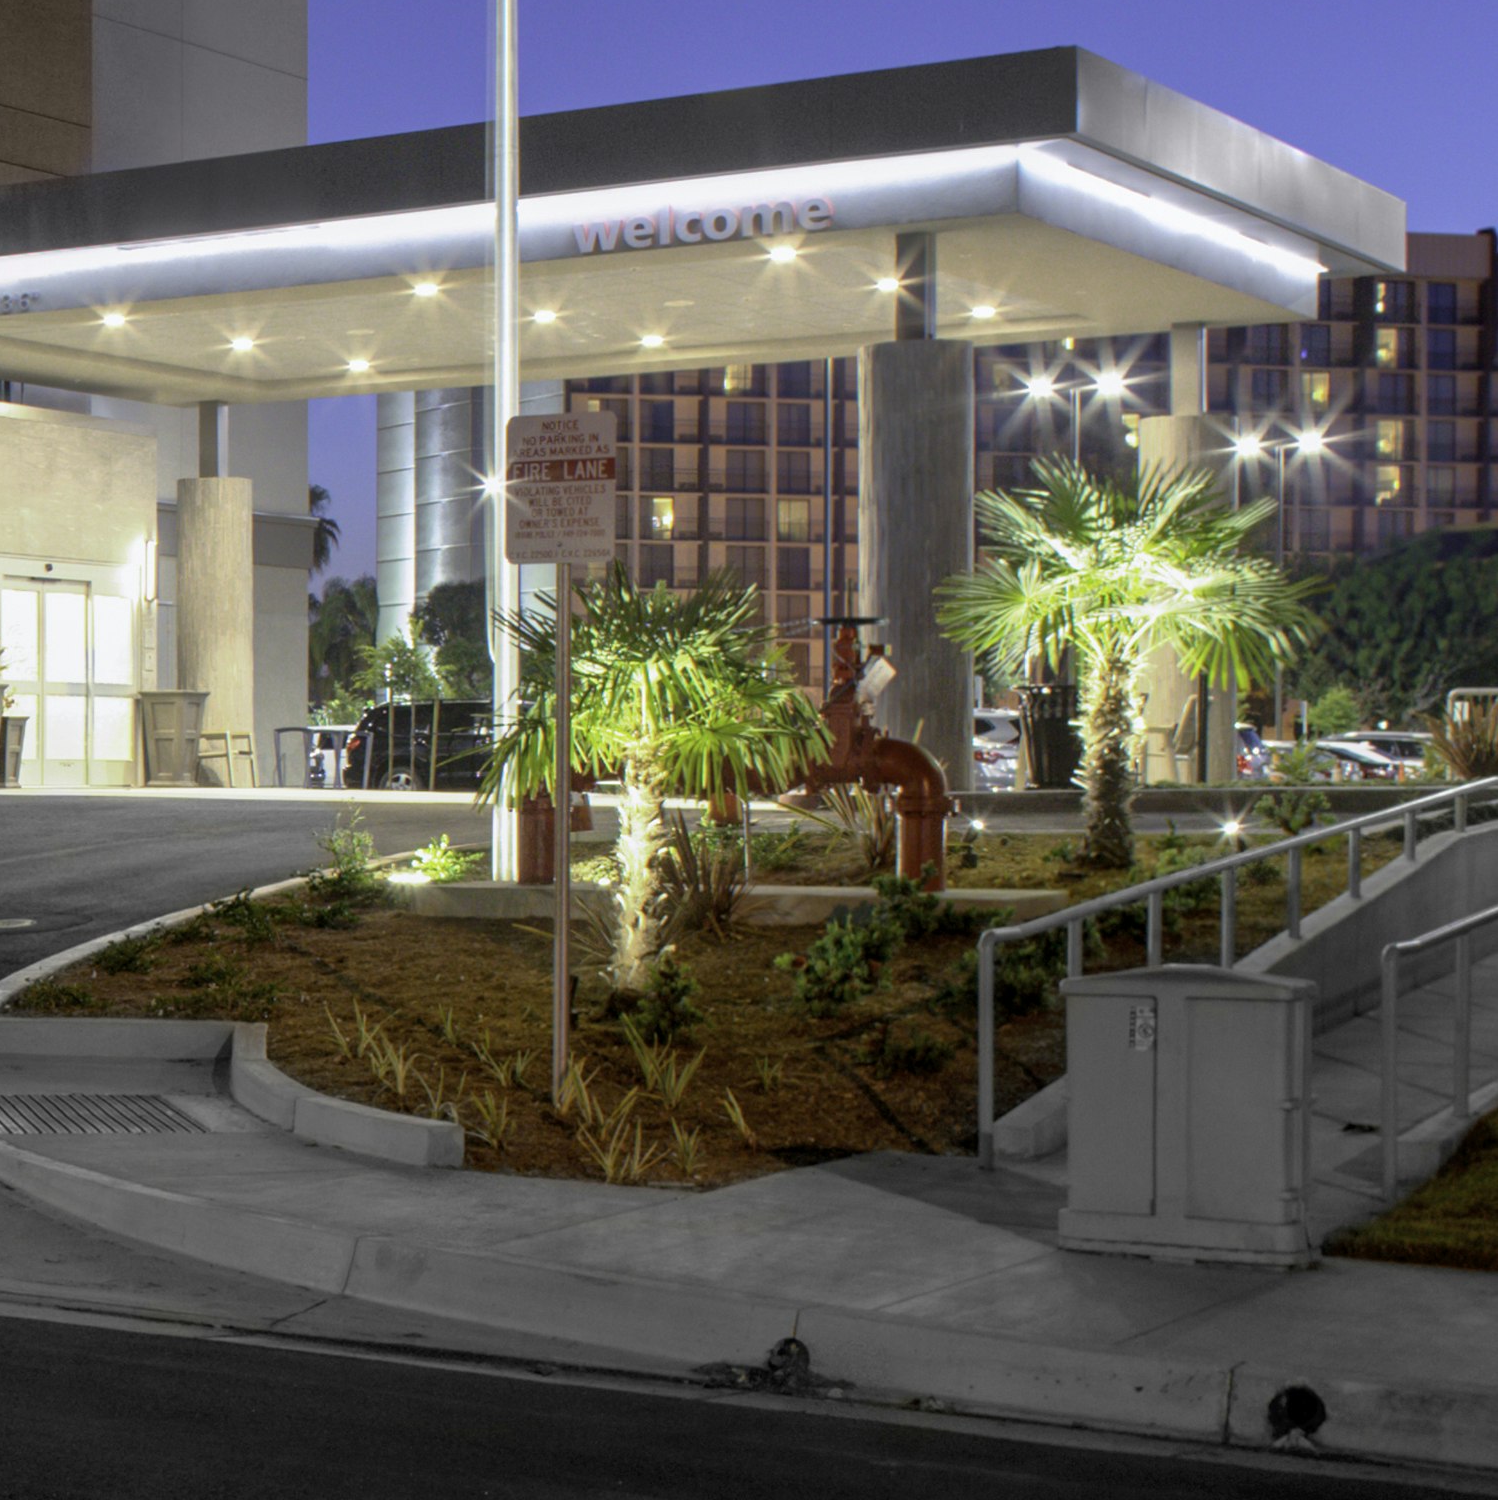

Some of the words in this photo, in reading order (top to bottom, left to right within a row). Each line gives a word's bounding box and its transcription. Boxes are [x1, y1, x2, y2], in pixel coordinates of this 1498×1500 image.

[572, 197, 833, 255] welcome
[541, 419, 579, 431] NOTICE
[522, 436, 536, 446] NO
[539, 434, 584, 445] PARKING
[589, 433, 600, 442] IN
[513, 447, 546, 458] AREAS
[550, 445, 592, 456] MARKED
[596, 444, 609, 453] AS
[512, 462, 552, 481] FIRE
[564, 460, 608, 479] LANE
[514, 486, 561, 497] VIOLATING
[563, 484, 606, 495] VEHICLES
[528, 498, 549, 508] WILL
[551, 496, 562, 507] BE
[566, 496, 592, 506] CITED
[531, 508, 543, 518] OR
[546, 507, 575, 517] TOWED
[577, 506, 588, 516] AT
[559, 517, 600, 528] EXPENSE
